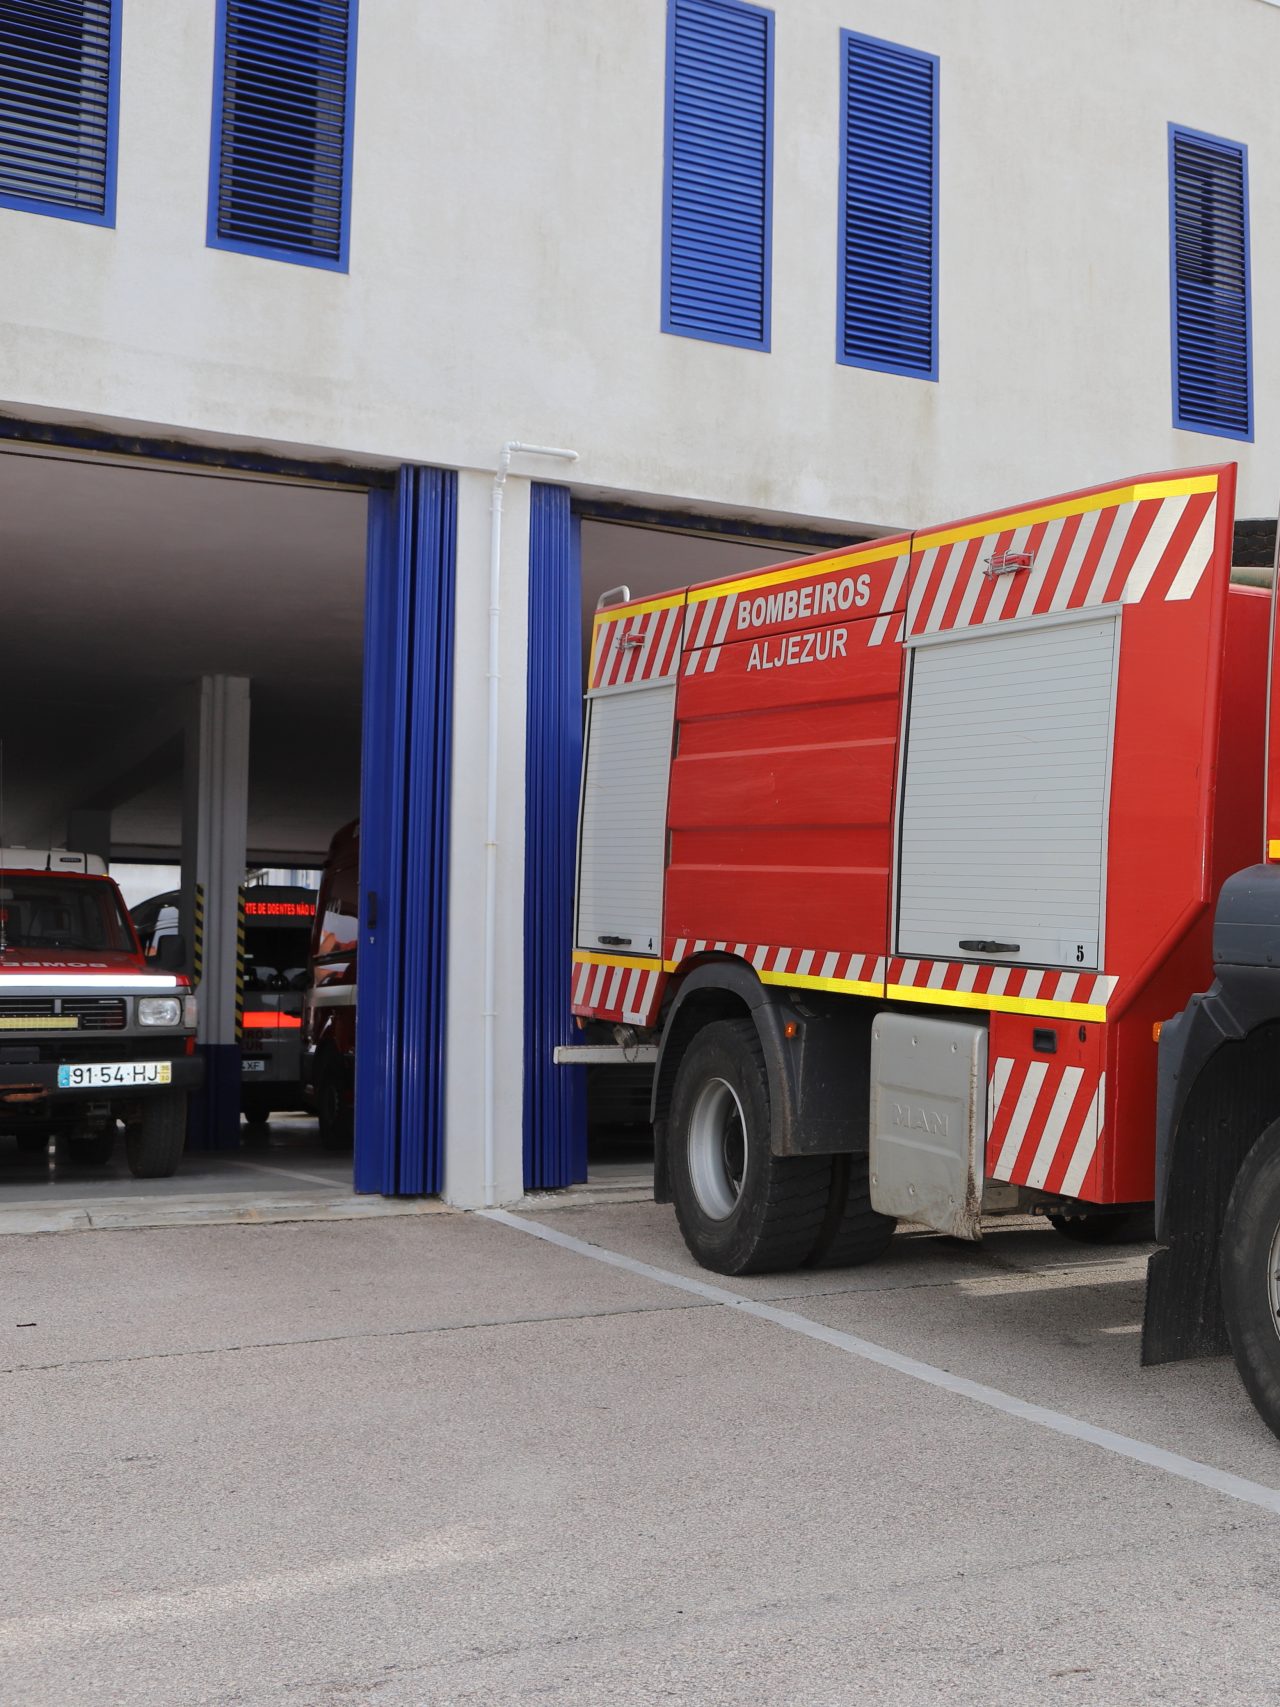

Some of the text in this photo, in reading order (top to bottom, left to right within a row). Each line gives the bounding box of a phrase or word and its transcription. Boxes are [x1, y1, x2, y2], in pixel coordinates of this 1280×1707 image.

[736, 573, 871, 630] BOMBEIROS
[746, 627, 848, 672] ALJEZUR
[257, 903, 266, 915] DE
[267, 903, 295, 916] DOENTES
[648, 937, 653, 951] 4
[1076, 944, 1085, 963] 5
[1078, 1024, 1087, 1044] 6
[892, 1103, 950, 1137] MAN
